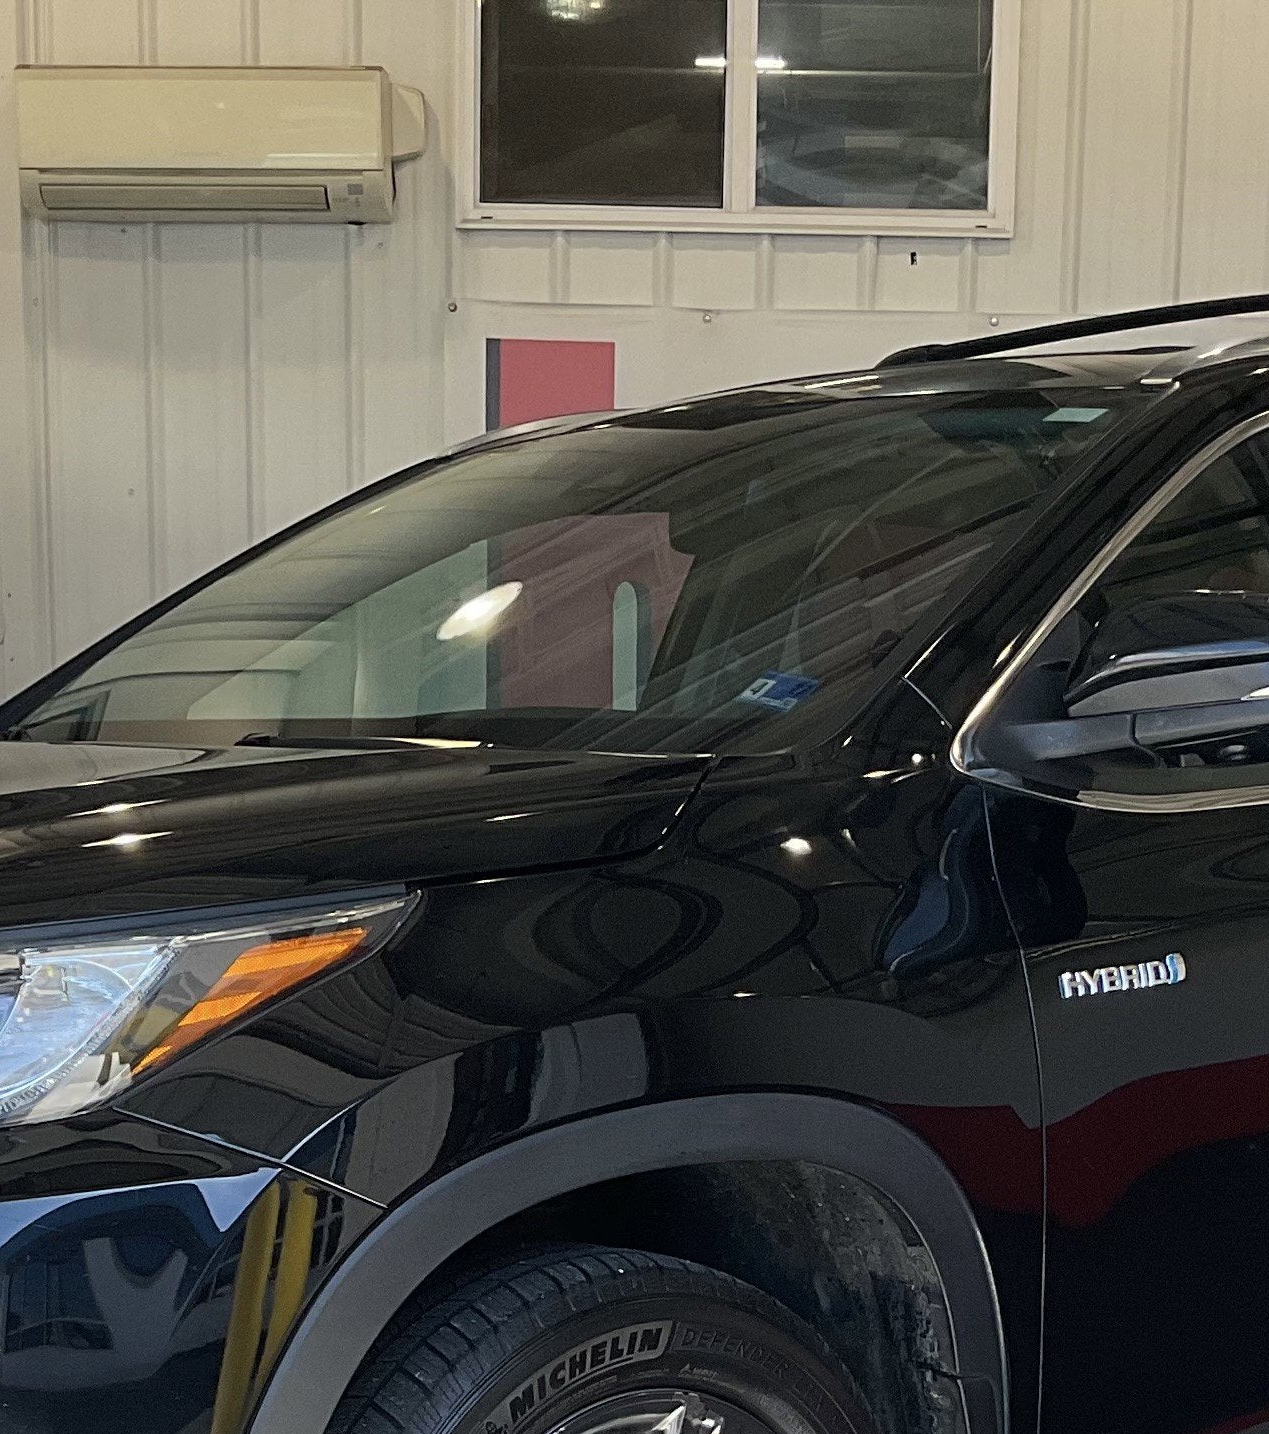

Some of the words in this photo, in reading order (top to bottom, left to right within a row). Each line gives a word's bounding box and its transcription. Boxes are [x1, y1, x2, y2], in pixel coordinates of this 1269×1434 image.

[1058, 959, 1169, 1000] HYBRID
[509, 1326, 665, 1425] MICHELIN
[680, 1324, 790, 1379] DEFENDER
